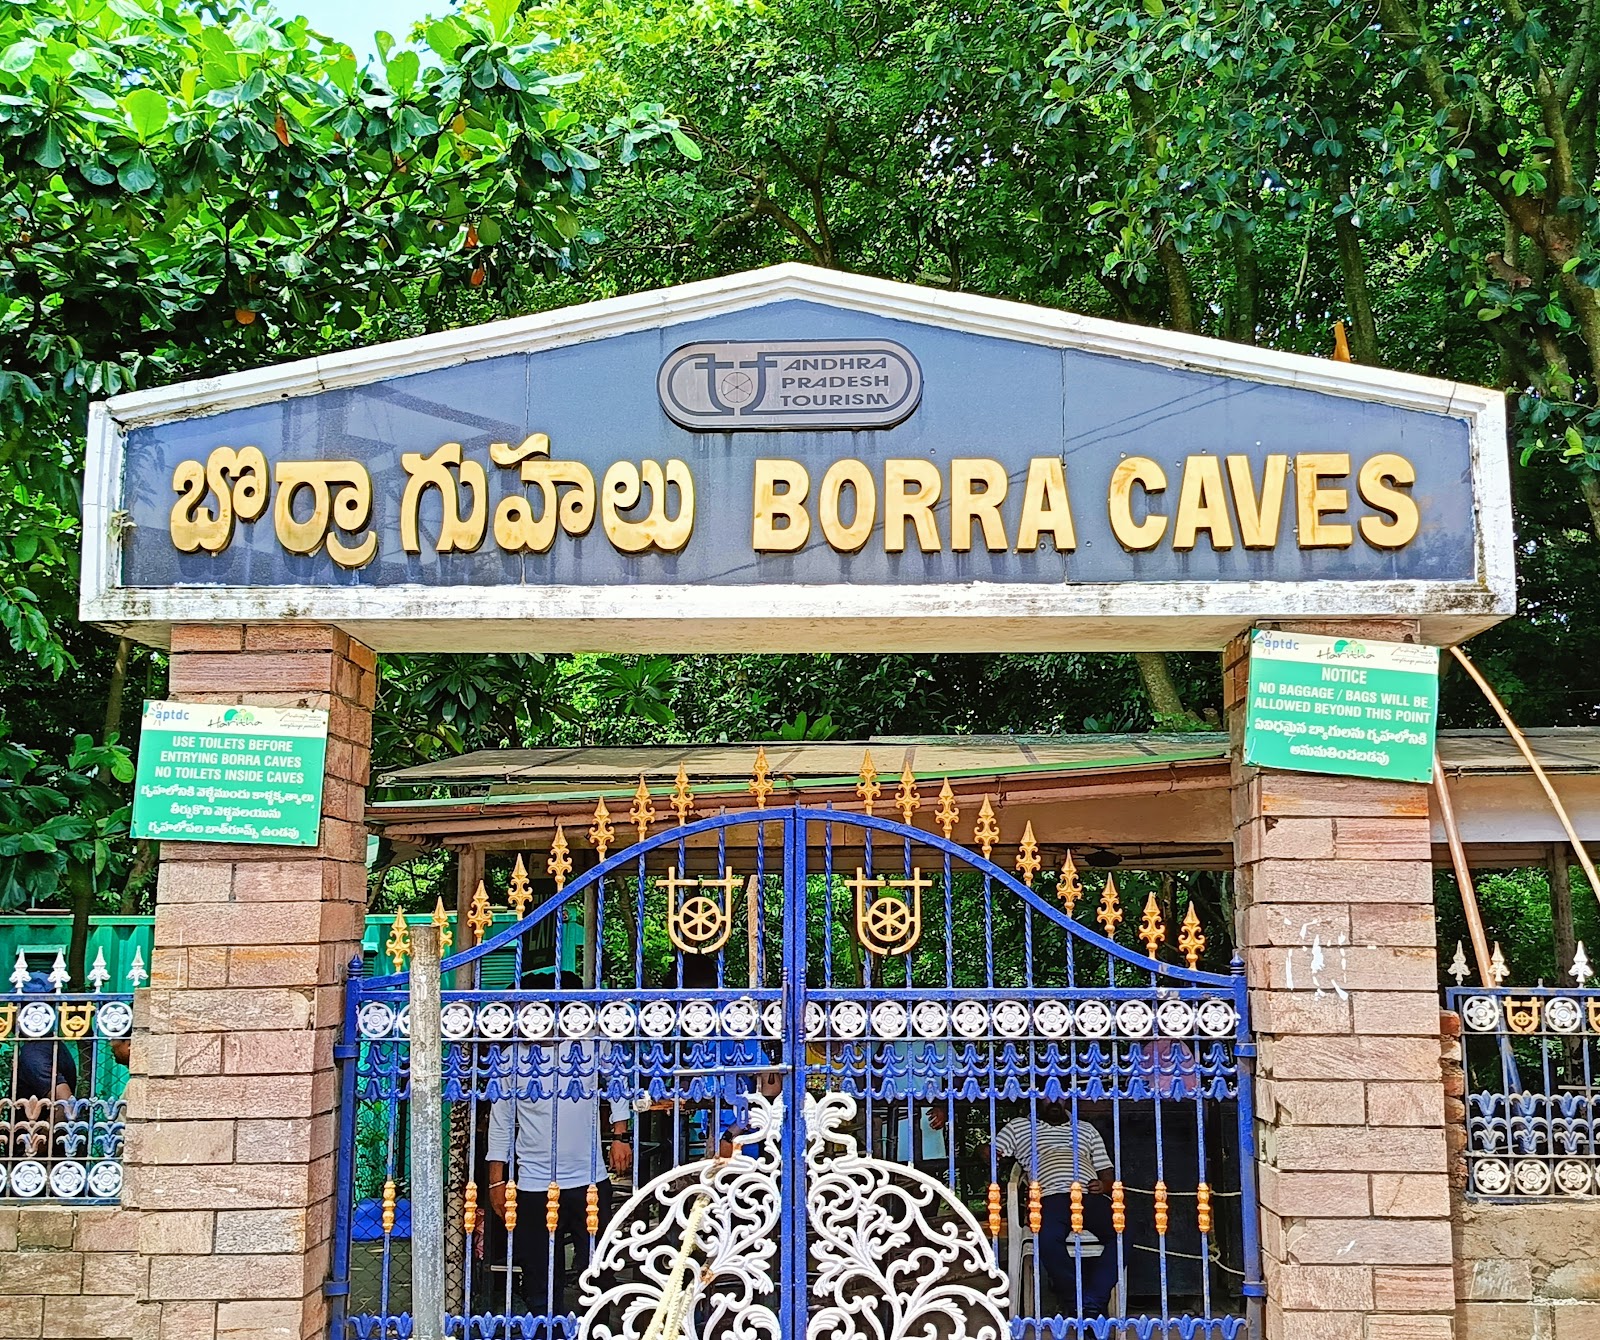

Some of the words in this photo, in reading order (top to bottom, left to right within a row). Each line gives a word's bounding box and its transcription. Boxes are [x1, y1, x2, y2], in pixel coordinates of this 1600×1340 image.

[783, 357, 887, 371] ANDHRA
[782, 375, 889, 389] PRADESH
[780, 393, 889, 407] TOURISM
[753, 458, 1077, 552] BORRA
[1108, 453, 1420, 552] CAVES
[1264, 638, 1299, 650] aptdc
[1316, 646, 1376, 660] Haritha
[1321, 667, 1367, 684] NOTICE
[1259, 682, 1275, 693] NO
[1279, 685, 1334, 700] BAGGAGE
[1336, 689, 1343, 701] /
[1346, 690, 1377, 703] BAGS
[1381, 692, 1410, 706] WILL
[155, 709, 190, 721] aptdc
[1254, 697, 1311, 713] ALLOWED
[1314, 703, 1362, 717] BEYOND
[1365, 707, 1392, 720] THIS
[1395, 710, 1431, 724] POINT
[207, 714, 262, 728] Haritha
[172, 736, 196, 748] USE
[199, 737, 245, 751] TOILETS
[248, 739, 293, 752] BEFORE
[160, 751, 218, 765] ENTRYING
[221, 754, 261, 767] BORRA
[264, 756, 302, 768] CAVES
[155, 767, 172, 778] NO
[175, 767, 221, 780] TOILETS
[224, 770, 263, 782] INSIDE
[266, 772, 304, 784] CAVES
